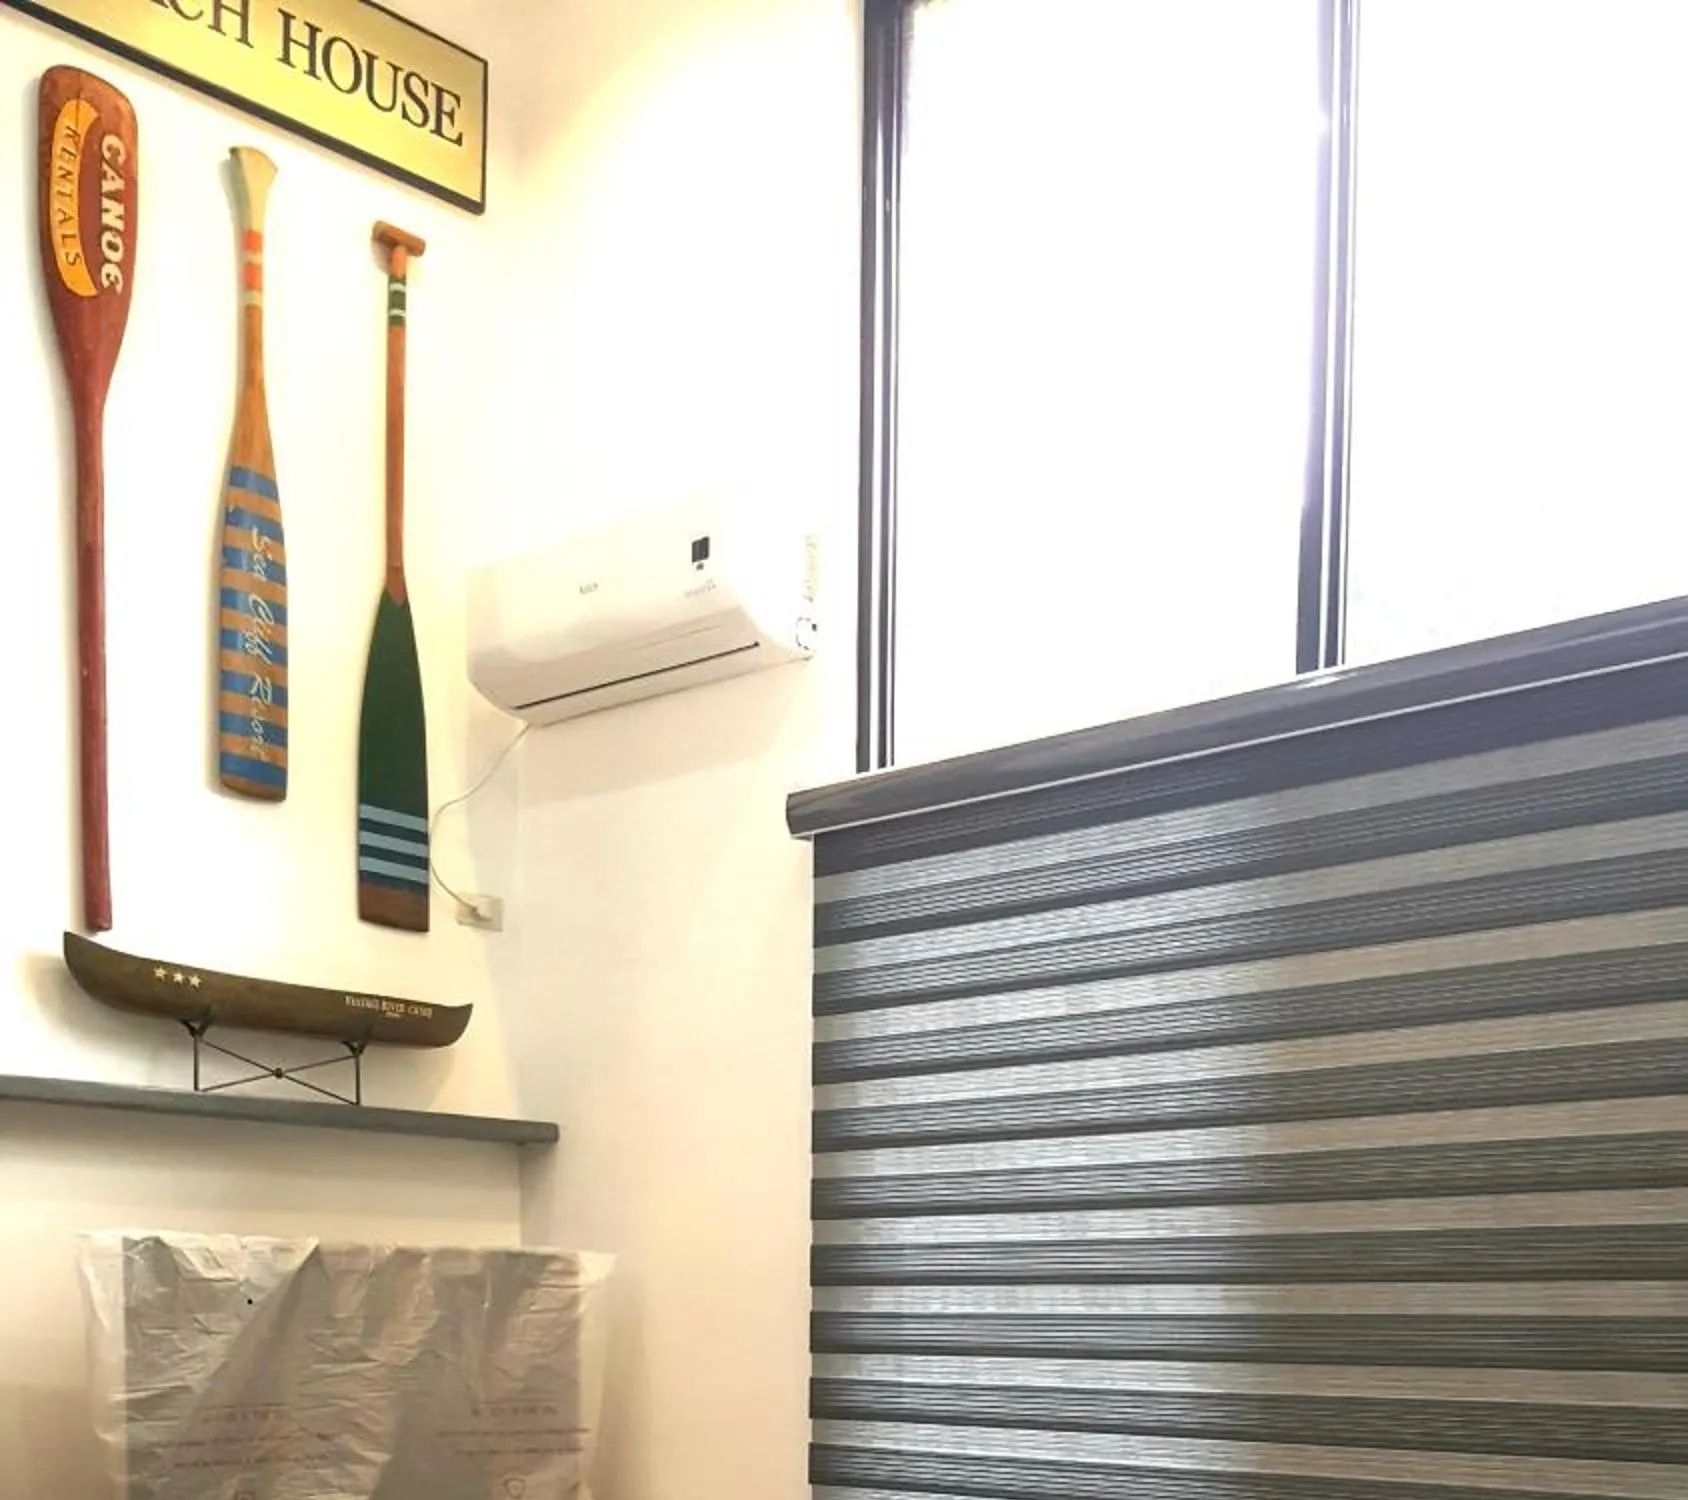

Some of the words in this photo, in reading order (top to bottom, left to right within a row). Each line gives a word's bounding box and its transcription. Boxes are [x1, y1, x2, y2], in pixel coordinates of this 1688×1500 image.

[277, 8, 463, 147] HOUSE
[56, 125, 81, 266] RENTALS
[252, 525, 272, 581] Sea
[244, 594, 274, 665] Cliff
